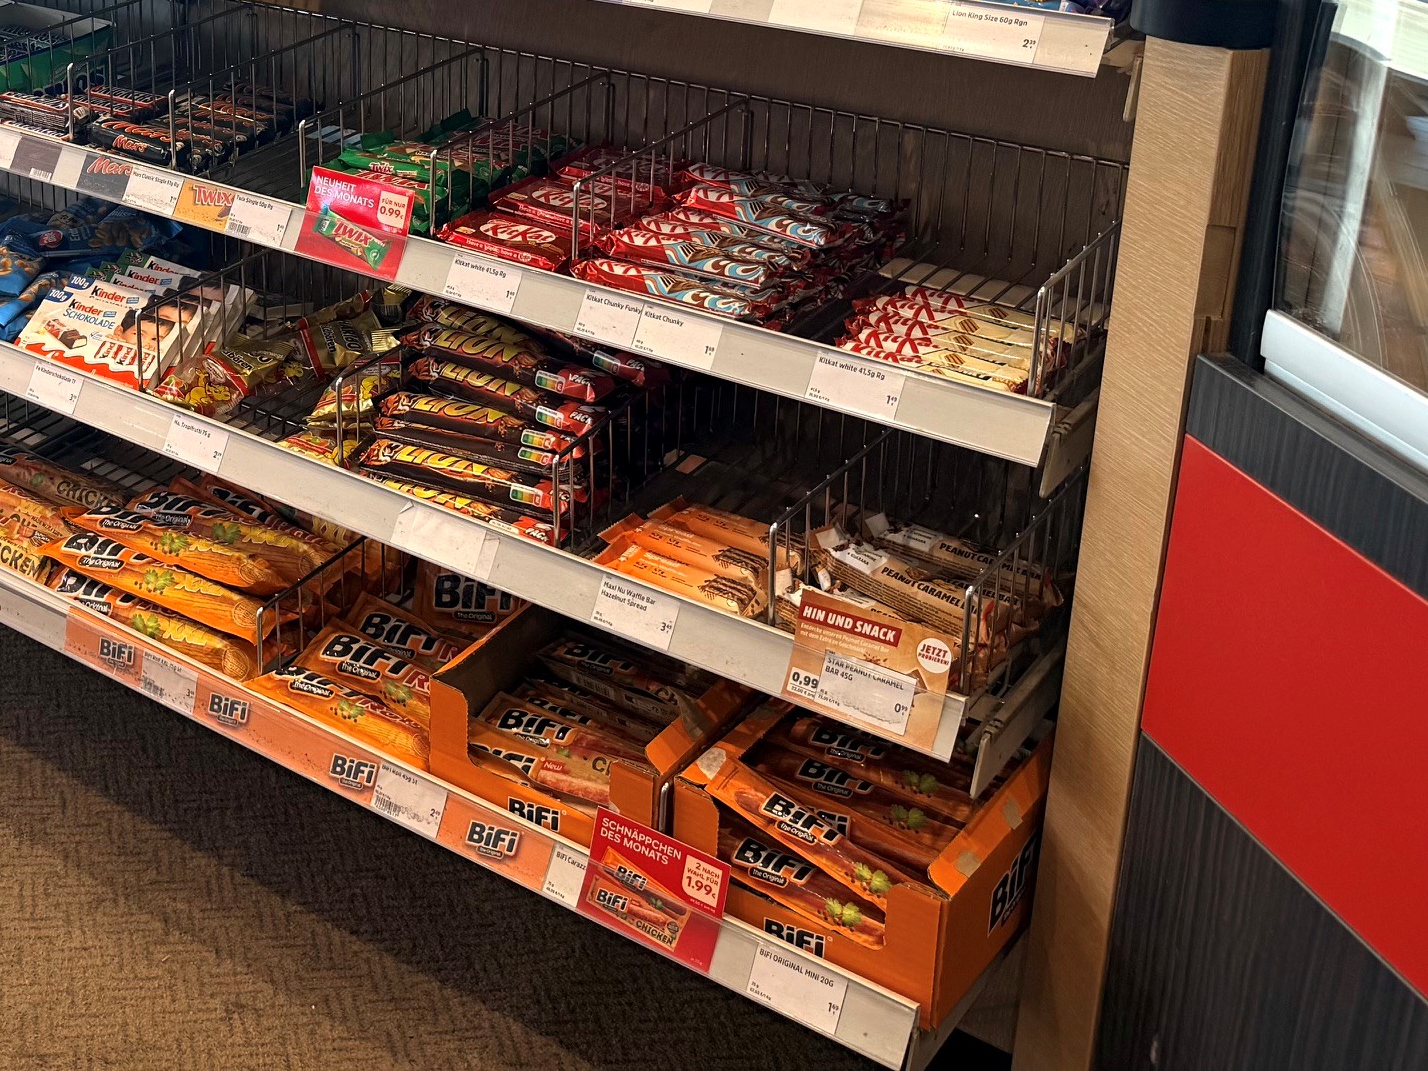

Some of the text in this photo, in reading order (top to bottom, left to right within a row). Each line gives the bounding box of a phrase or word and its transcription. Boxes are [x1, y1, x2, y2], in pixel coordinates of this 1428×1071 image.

[952, 10, 968, 18] Lion
[968, 12, 984, 22] King
[984, 13, 998, 22] Size
[999, 16, 1013, 26] 60g
[112, 135, 148, 153] Mars
[316, 175, 357, 193] NEUHEIT
[314, 184, 375, 208] DES MONATS
[381, 197, 393, 205] FÜR
[481, 220, 557, 244] KitKat
[48, 289, 68, 303] 100g
[69, 298, 104, 317] Kinder
[62, 307, 117, 330] SCHOKOLADE
[644, 310, 685, 328] Kitkat Chunky
[818, 356, 839, 368] Kitkat
[838, 361, 858, 372] white
[601, 589, 648, 612] Hazelnut Spread
[645, 596, 657, 606] Bar
[802, 605, 898, 643] HIN UND SNACK
[920, 643, 950, 659] JETZT
[791, 671, 820, 690] 0,99
[543, 761, 563, 771] New
[600, 827, 670, 866] DES MONATS
[601, 817, 682, 861] SCHNÄPPCHEN
[687, 867, 719, 887] WAHL FÜR
[695, 861, 721, 879] 2 NACH
[635, 920, 675, 947] CHICKEN
[772, 953, 804, 975] ORIGINAL
[804, 968, 820, 982] MINI
[820, 975, 834, 987] 20G
